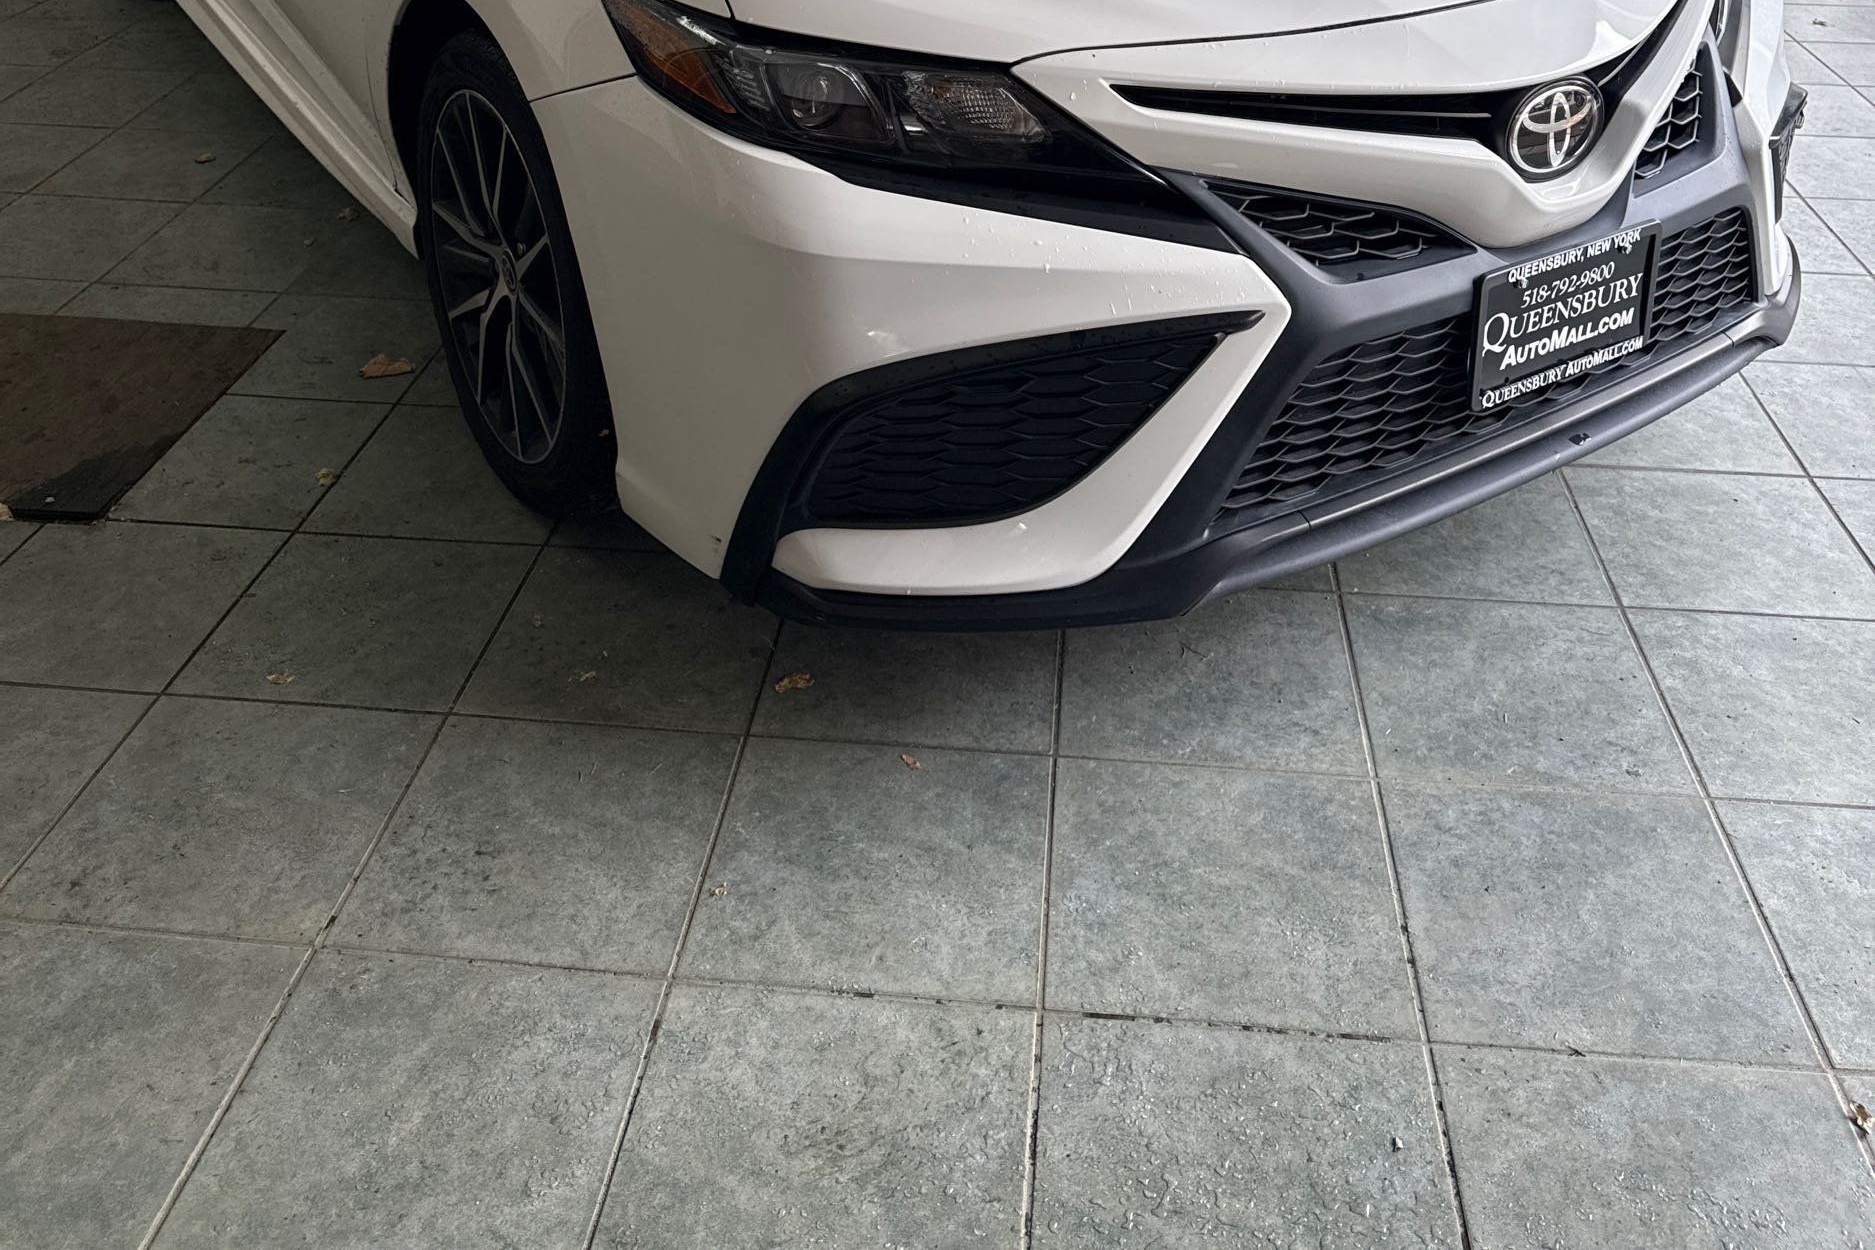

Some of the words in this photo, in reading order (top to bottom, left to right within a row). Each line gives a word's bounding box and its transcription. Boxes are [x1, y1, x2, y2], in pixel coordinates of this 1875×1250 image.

[1508, 247, 1584, 283] QUEENSBURY,
[1587, 238, 1611, 258] NEW
[1614, 229, 1641, 249] YORK
[1521, 261, 1615, 308] 518-792-9800
[1482, 273, 1643, 357] QUEENSBURY
[1481, 364, 1567, 409] QUEENSBURY
